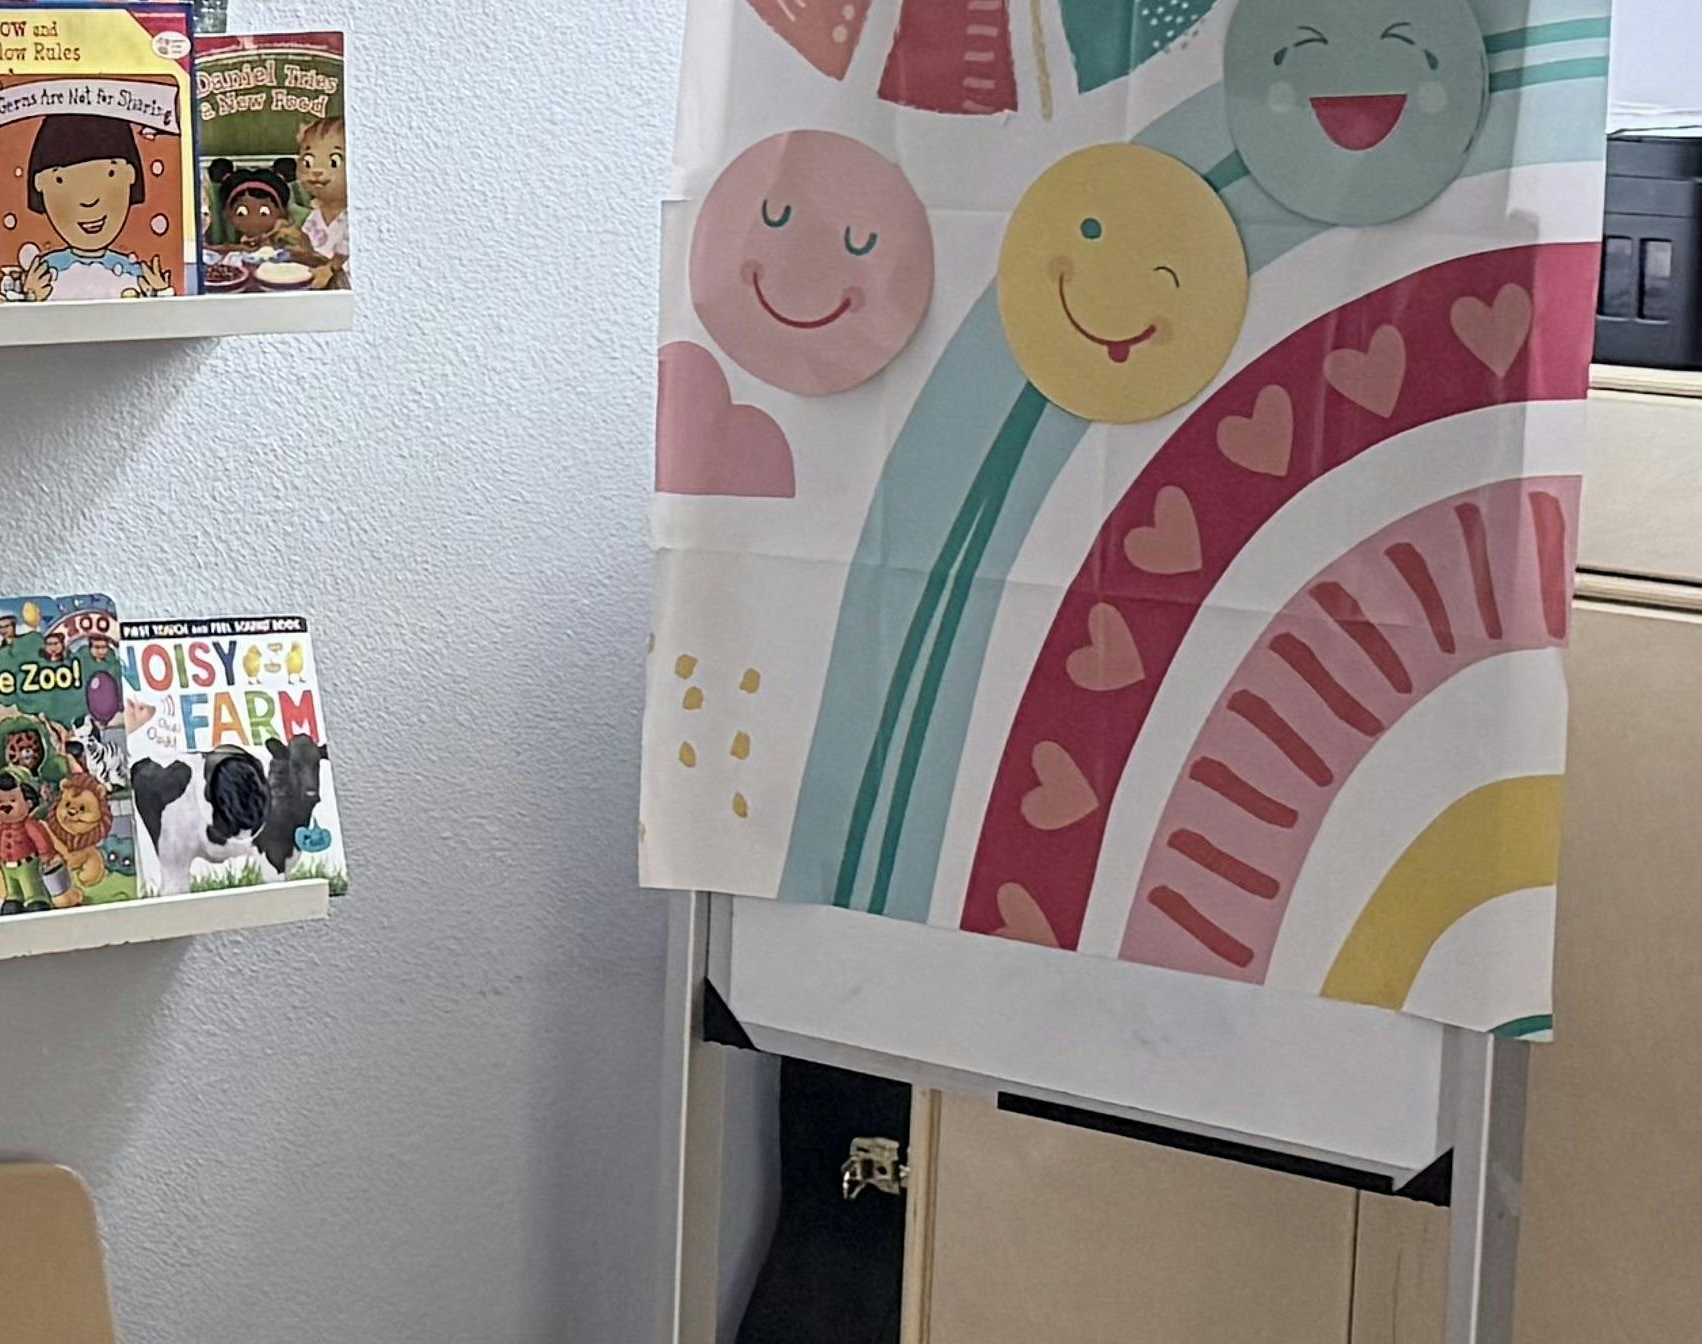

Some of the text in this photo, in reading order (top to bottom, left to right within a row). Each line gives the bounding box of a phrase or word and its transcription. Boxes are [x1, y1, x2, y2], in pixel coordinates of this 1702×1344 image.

[33, 21, 58, 37] and
[33, 41, 81, 61] Rules
[196, 60, 338, 98] Daniel Tries
[41, 88, 64, 105] Are
[69, 86, 91, 105] Not
[96, 91, 114, 105] for
[117, 90, 172, 125] Sharing
[201, 89, 328, 120] a New Food
[22, 659, 81, 691] Zoo!
[121, 640, 237, 691] NOISY
[179, 689, 319, 749] FARM
